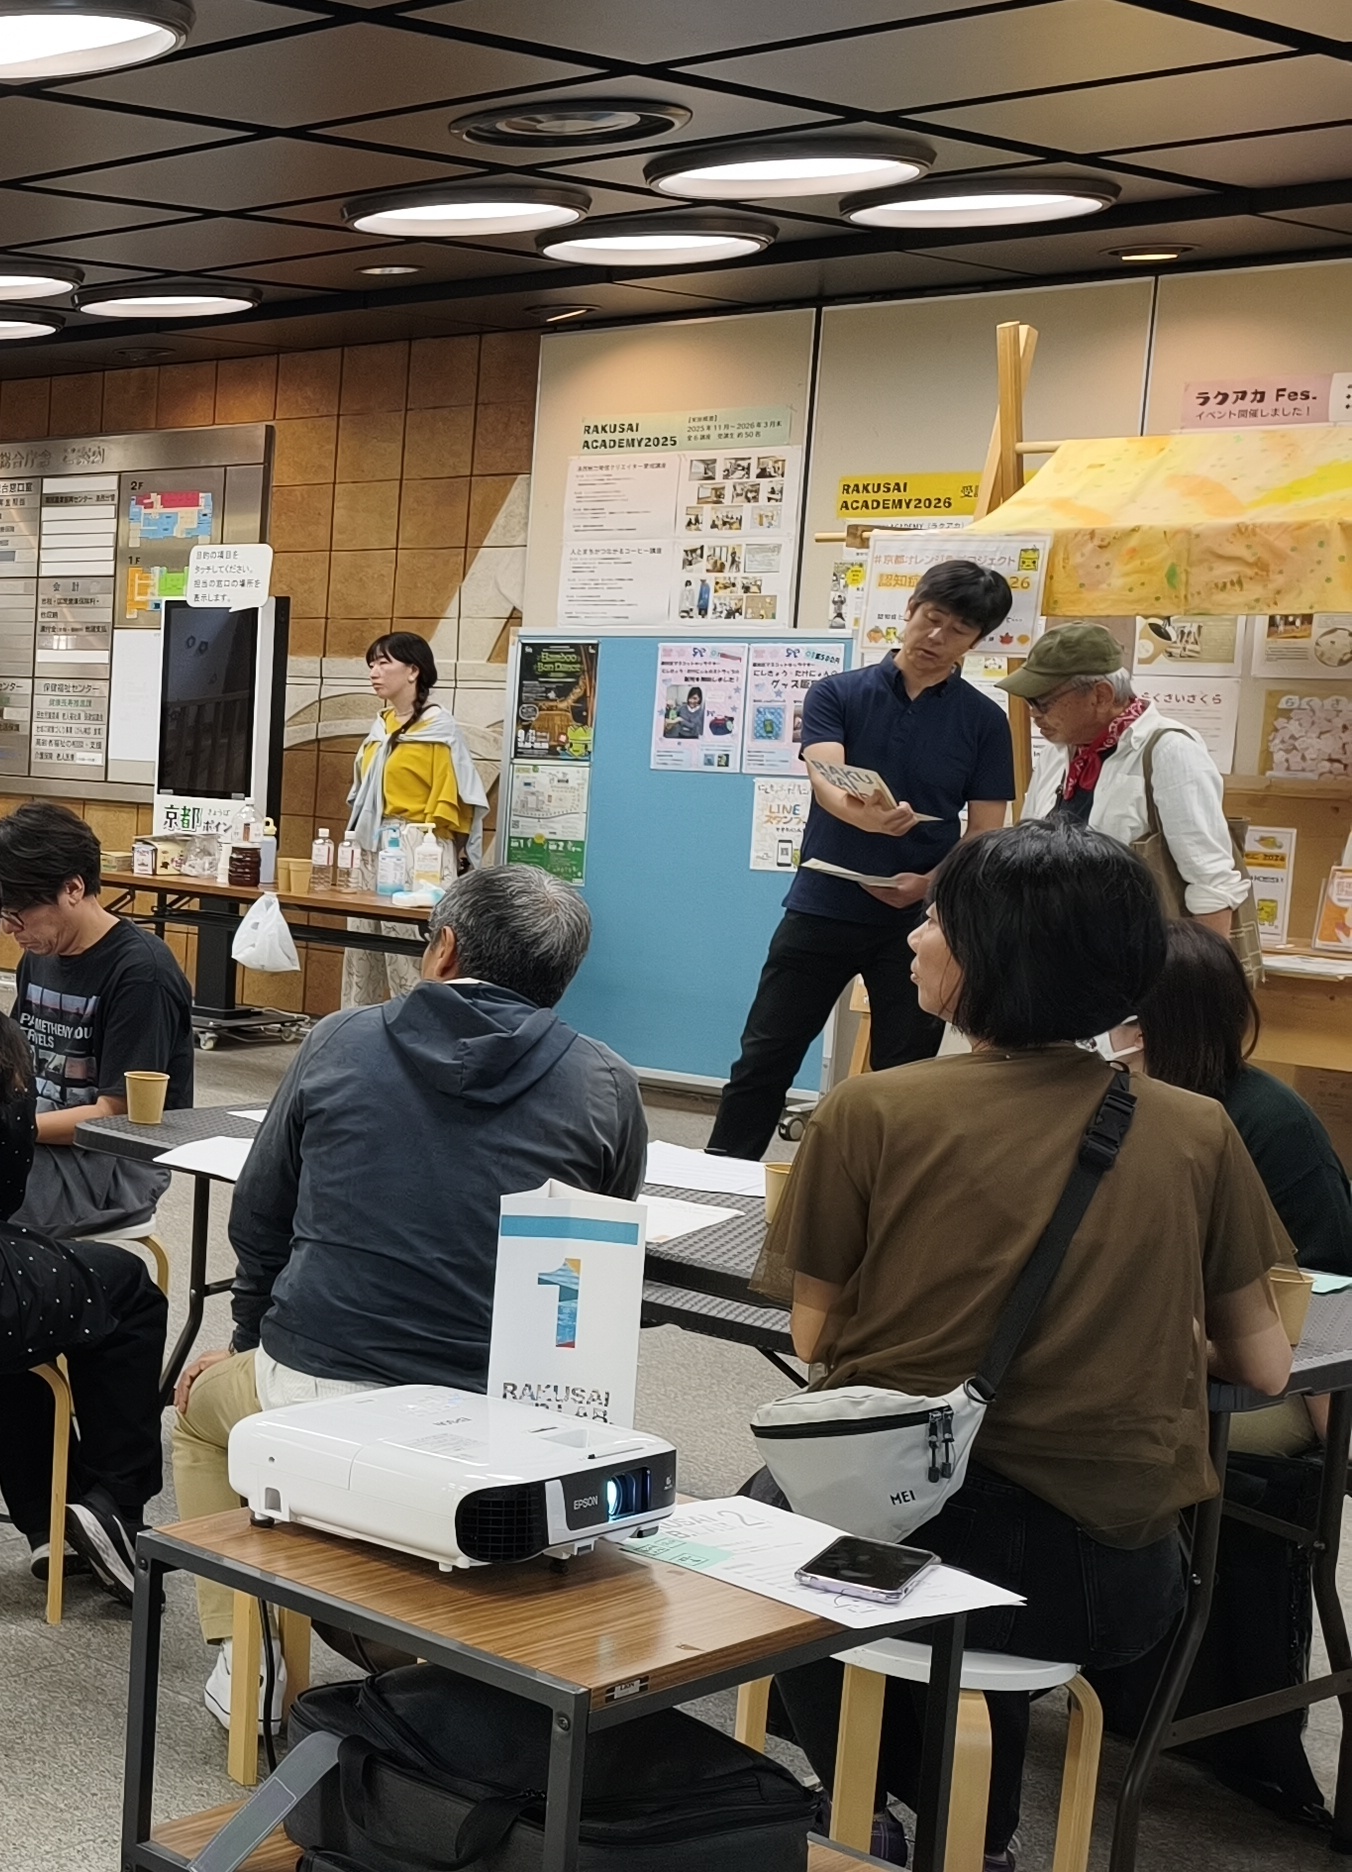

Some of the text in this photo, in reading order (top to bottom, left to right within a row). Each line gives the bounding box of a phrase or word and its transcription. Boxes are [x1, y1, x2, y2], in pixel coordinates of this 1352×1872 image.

[1196, 388, 1317, 406] ラクアカ Fes.
[583, 422, 639, 435] RAKUSAI
[582, 436, 678, 450] ACADEMY2025
[131, 481, 143, 491] 2F
[842, 482, 908, 495] RAKUSAI
[840, 497, 953, 511] ACADEMY2026
[128, 556, 141, 565] 1F
[537, 663, 554, 672] Bon
[768, 803, 801, 815] LINE
[163, 804, 204, 832] 京都
[537, 1258, 582, 1348] 1
[502, 1382, 610, 1407] RAKUSAI
[573, 1495, 599, 1511] EPSON
[890, 1490, 916, 1506] MEI
